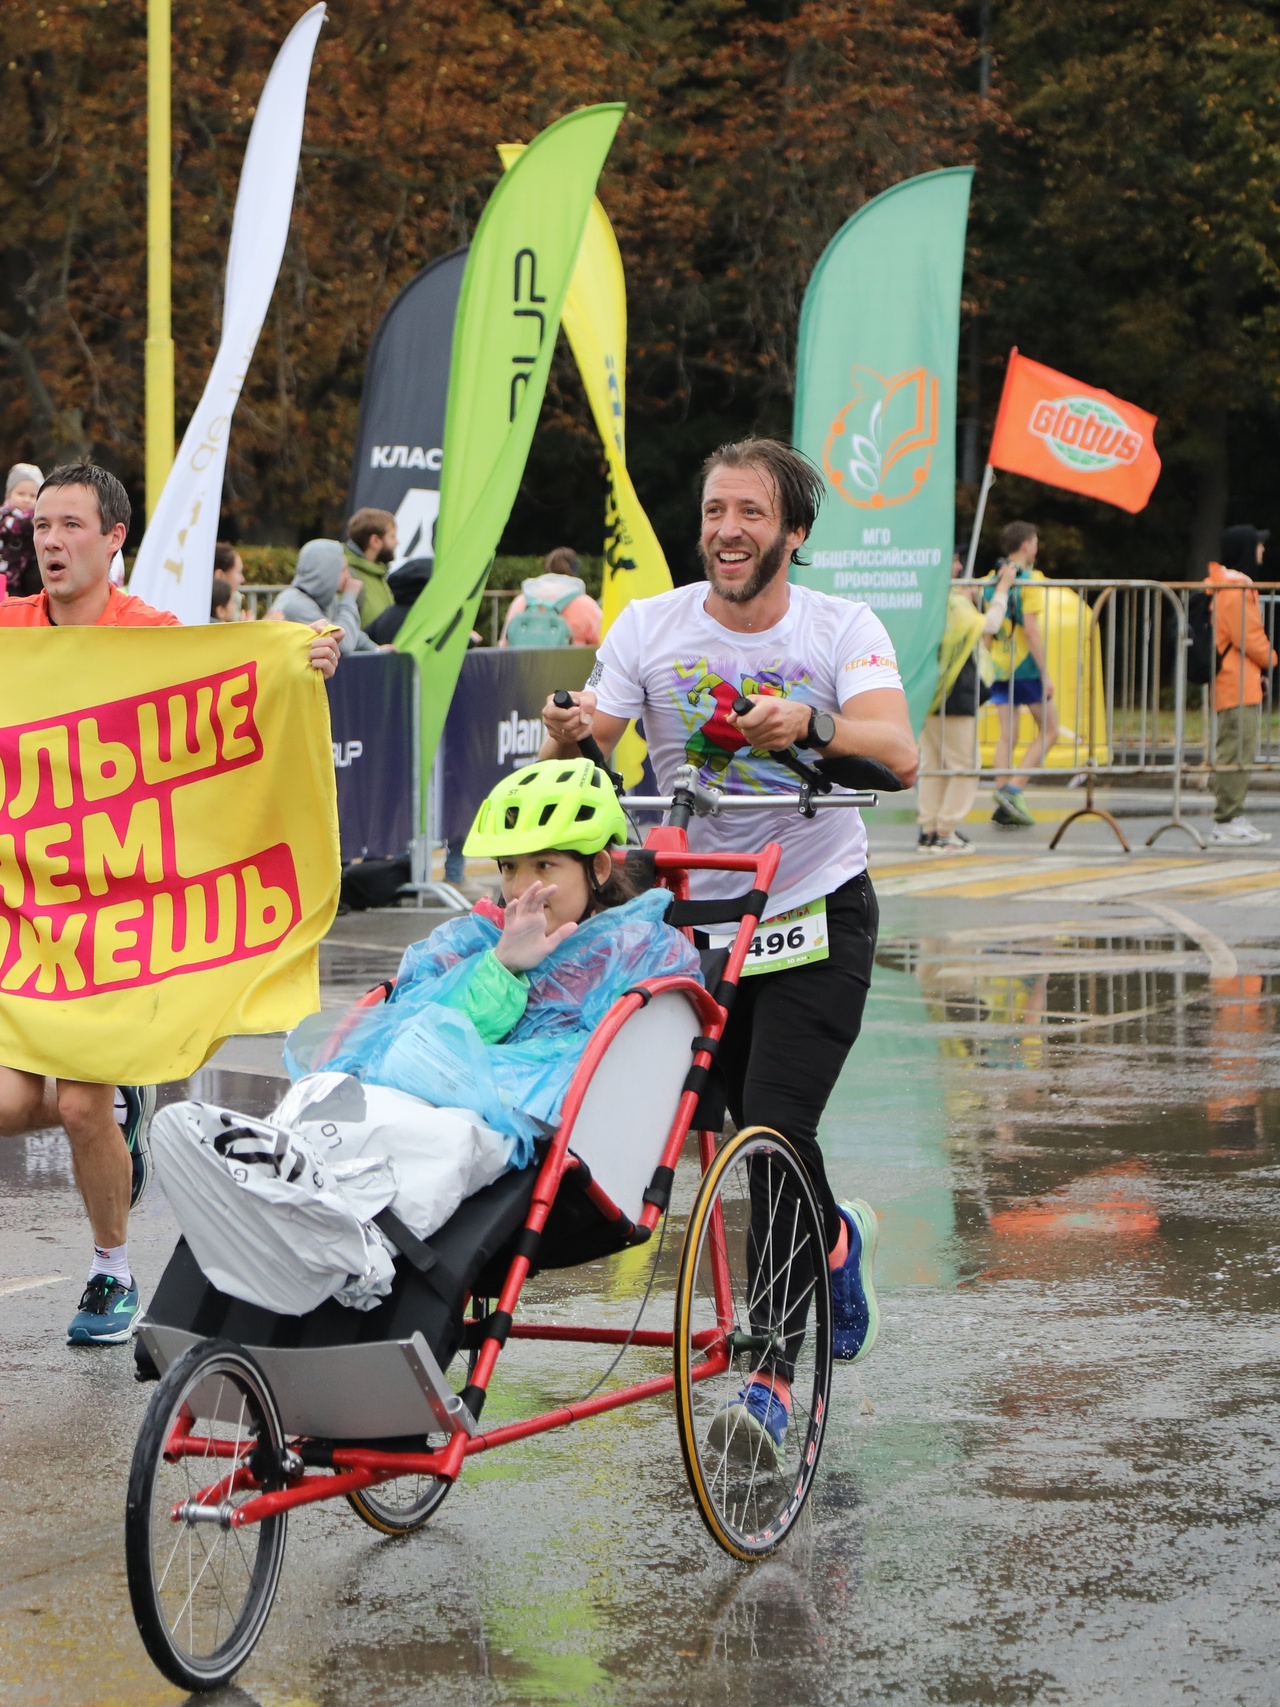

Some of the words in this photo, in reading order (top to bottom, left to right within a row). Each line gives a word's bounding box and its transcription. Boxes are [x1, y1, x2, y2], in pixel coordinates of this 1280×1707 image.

[1032, 402, 1138, 461] Globus
[863, 528, 891, 545] МГО
[812, 547, 941, 568] ОБЩЕРОССИЙСКОГО
[834, 571, 918, 589] ПРОФСОЮЗА
[834, 592, 923, 609] РАЗОВАНИЯ
[762, 906, 811, 924] ОСКВА
